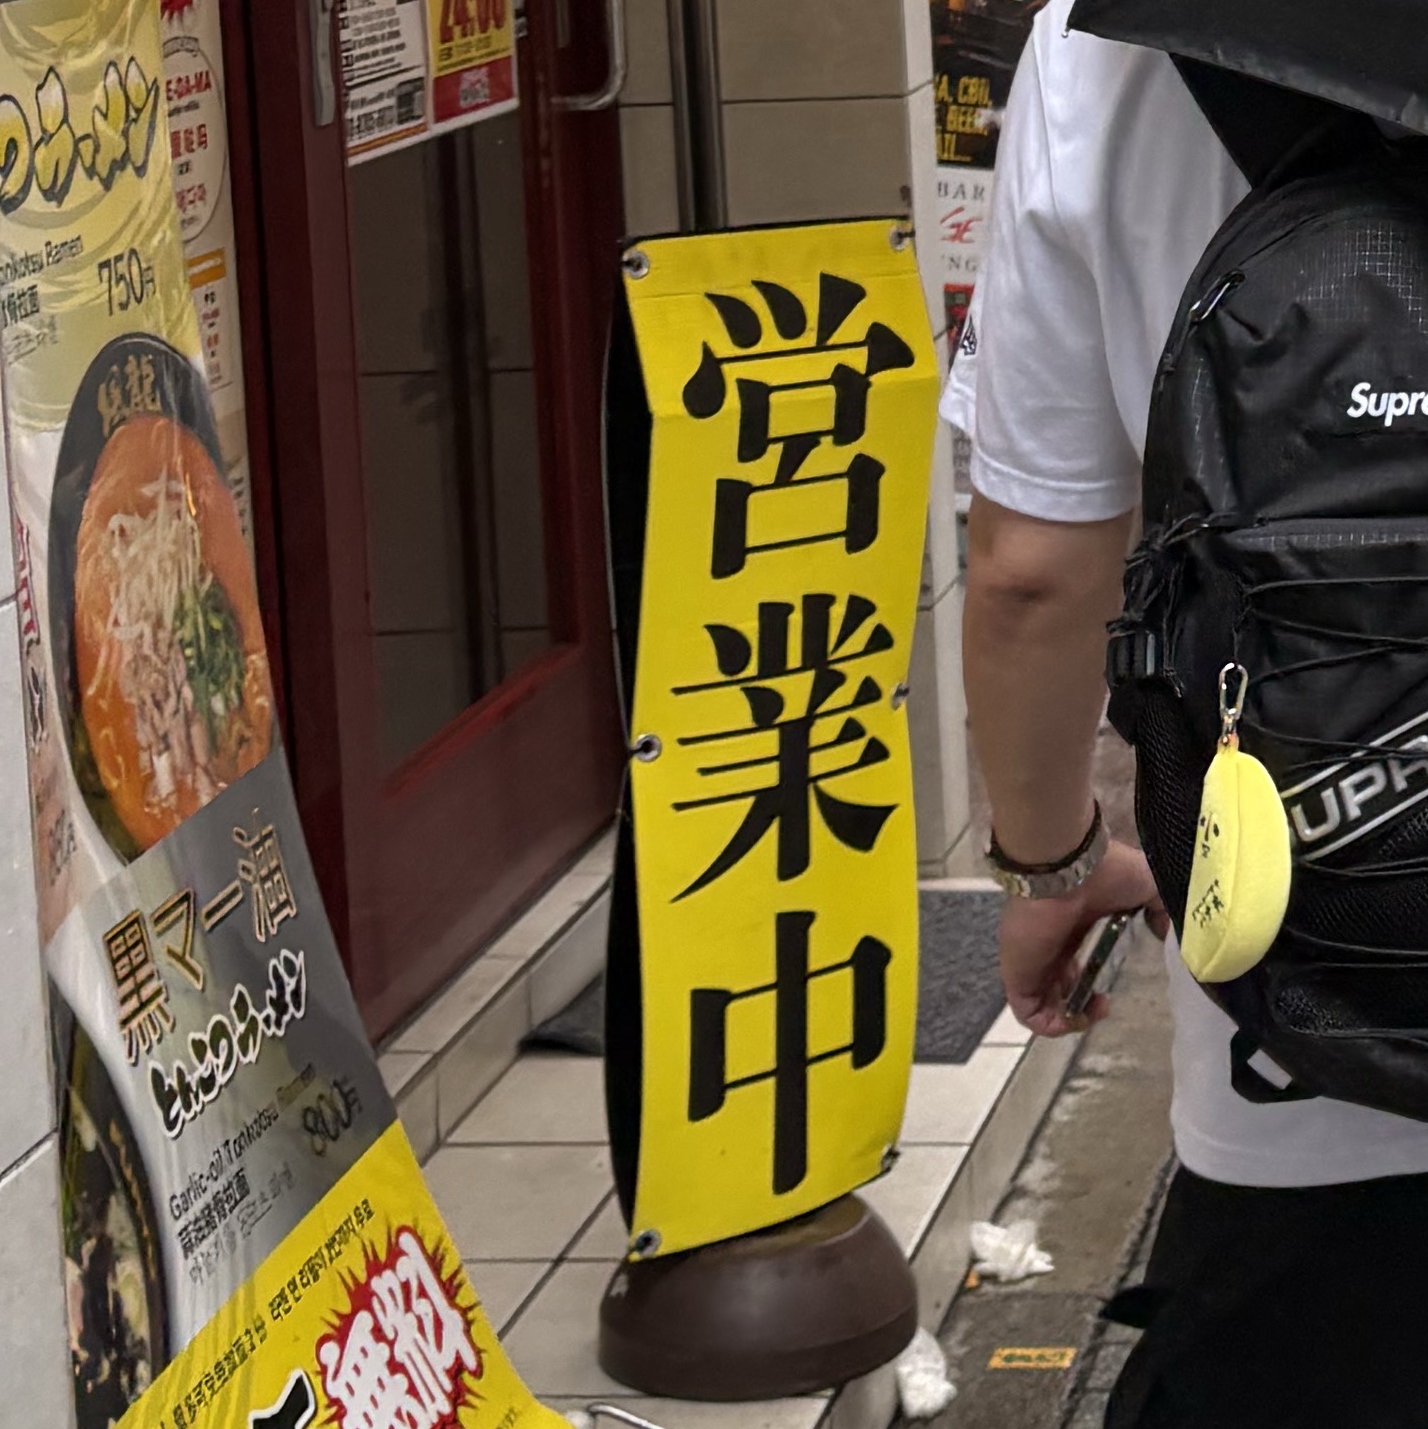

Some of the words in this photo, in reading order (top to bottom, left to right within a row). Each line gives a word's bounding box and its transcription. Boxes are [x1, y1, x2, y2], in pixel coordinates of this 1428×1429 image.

[101, 807, 298, 1066] 黒マー油
[669, 270, 916, 1196] 営業中
